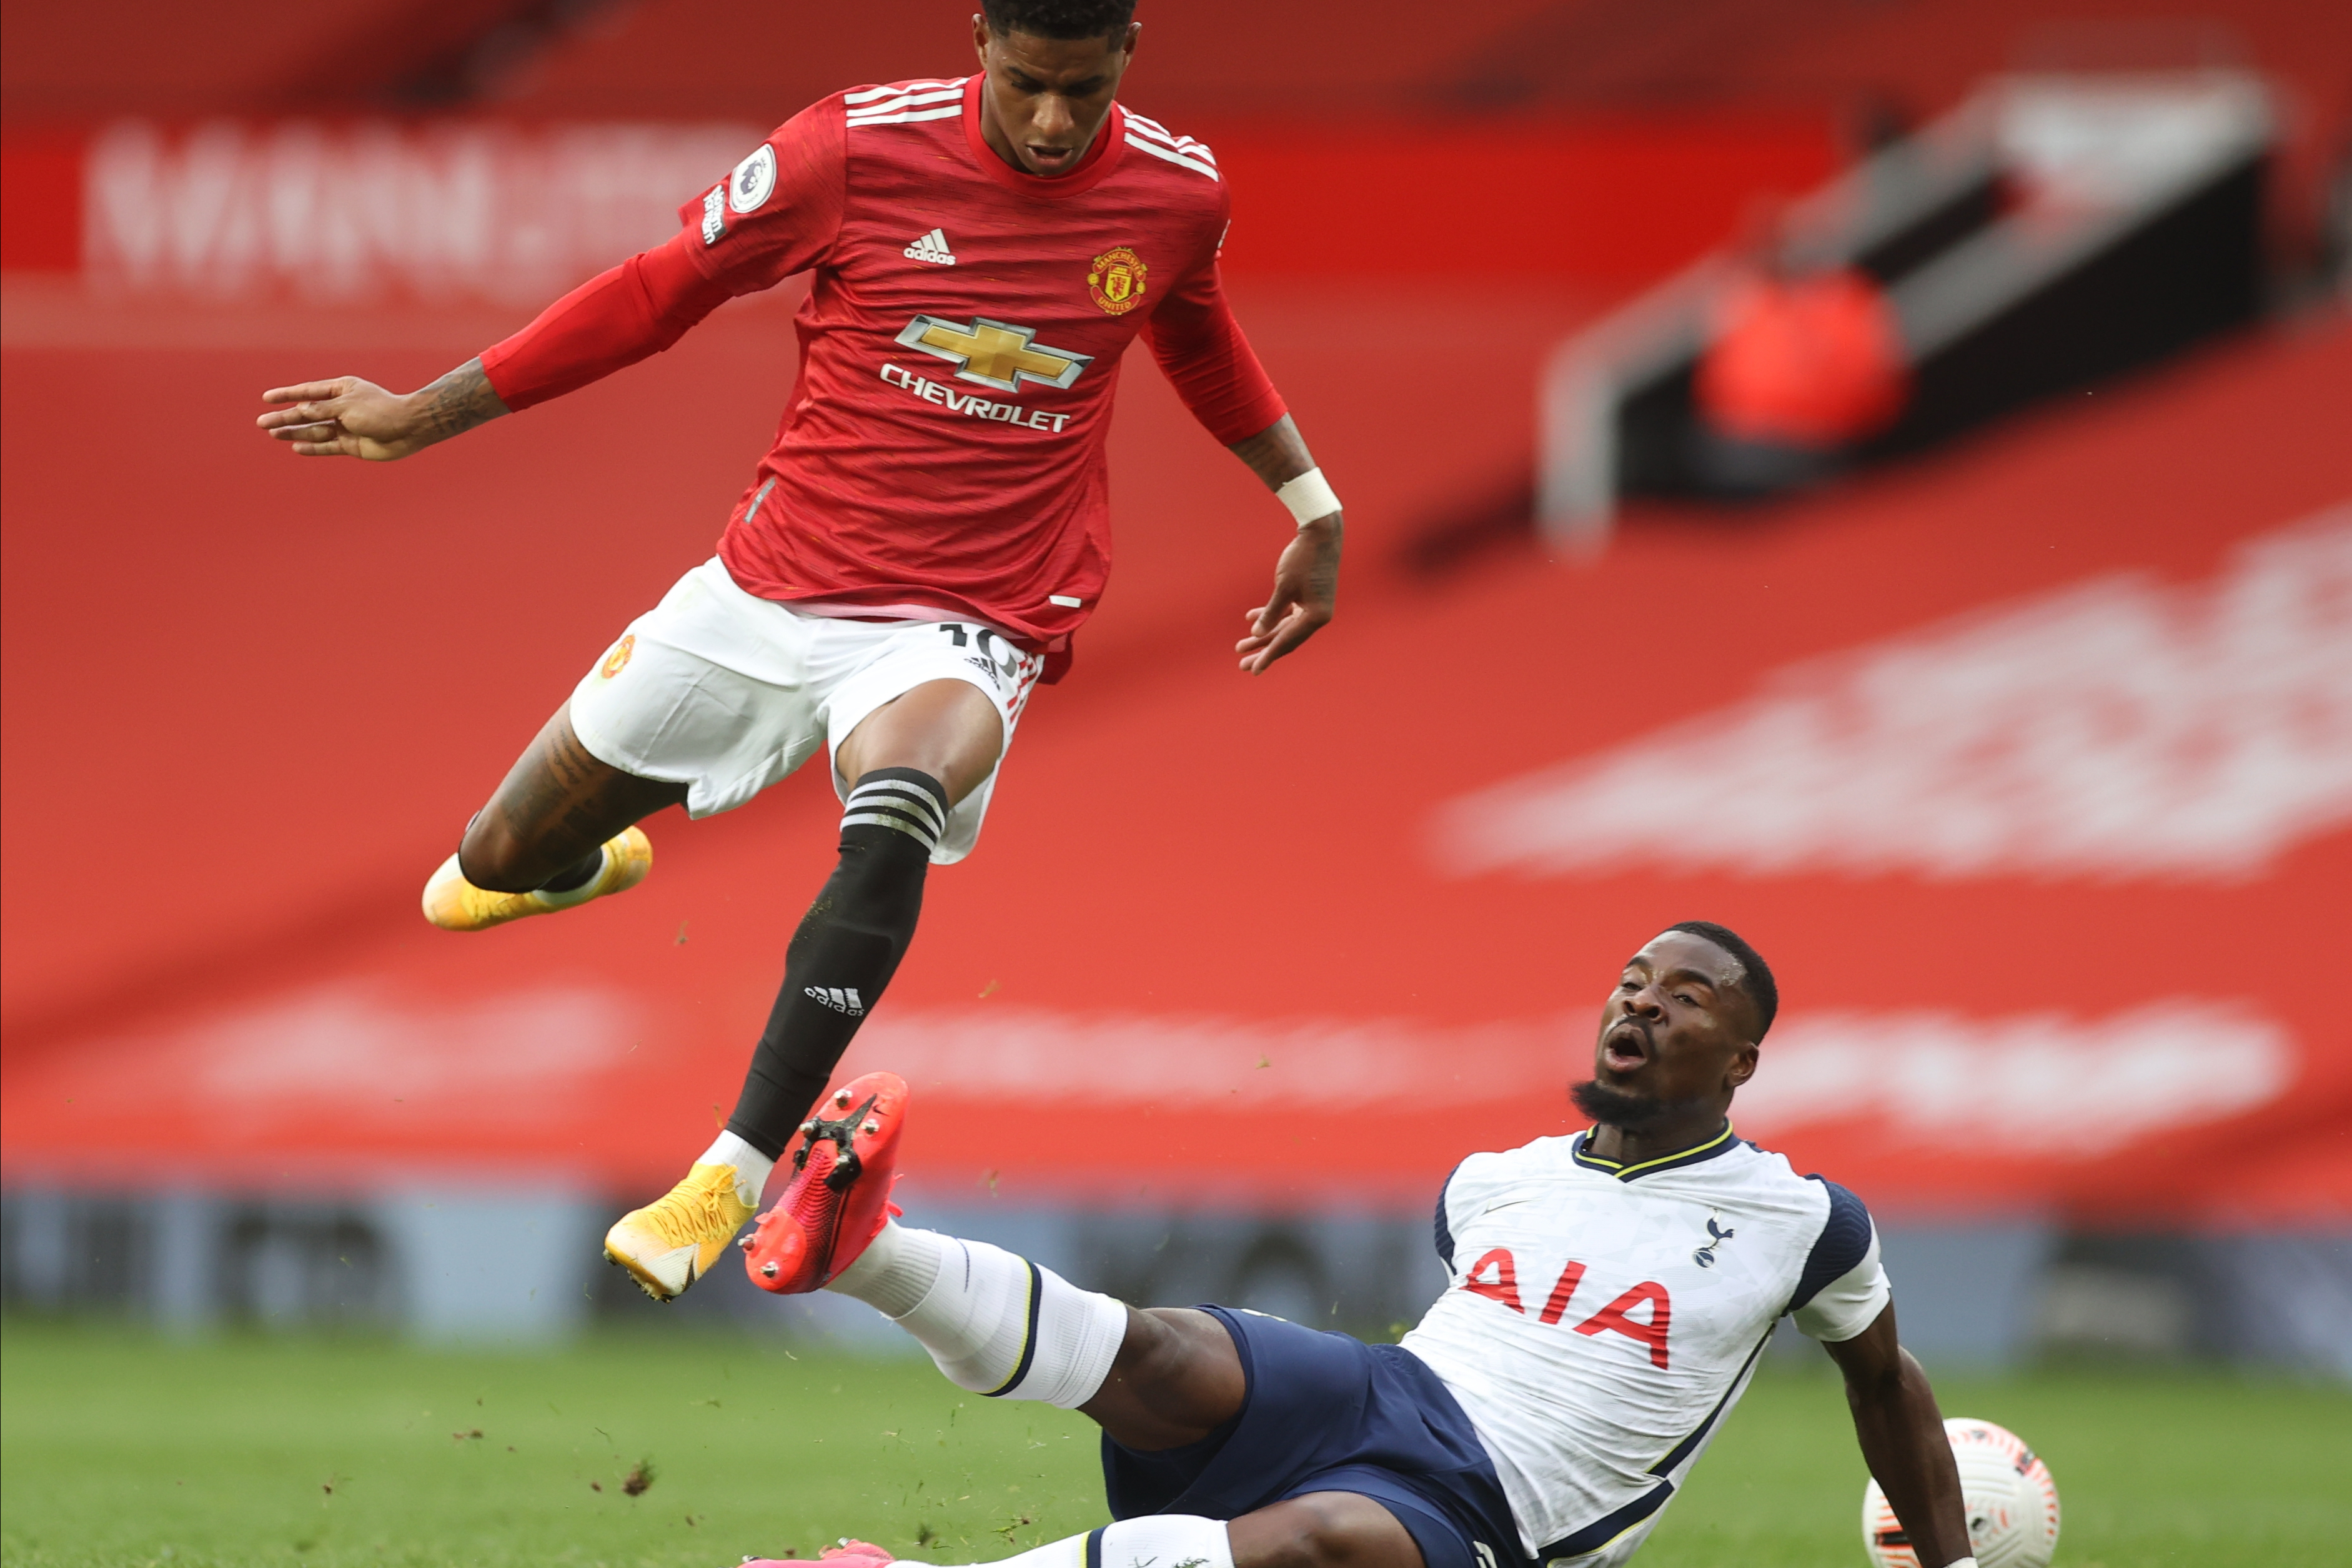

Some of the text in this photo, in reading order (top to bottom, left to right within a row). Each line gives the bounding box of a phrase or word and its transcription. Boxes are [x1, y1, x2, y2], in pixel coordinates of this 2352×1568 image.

[903, 247, 956, 266] adidas
[1096, 251, 1144, 276] MANCHESTER
[1098, 296, 1132, 310] UNITED
[880, 363, 1071, 434] CHEVROLET
[939, 624, 1017, 678] 10
[963, 658, 1001, 692] adidas
[804, 987, 865, 1016] adidas
[1459, 1248, 1670, 1371] AIA
